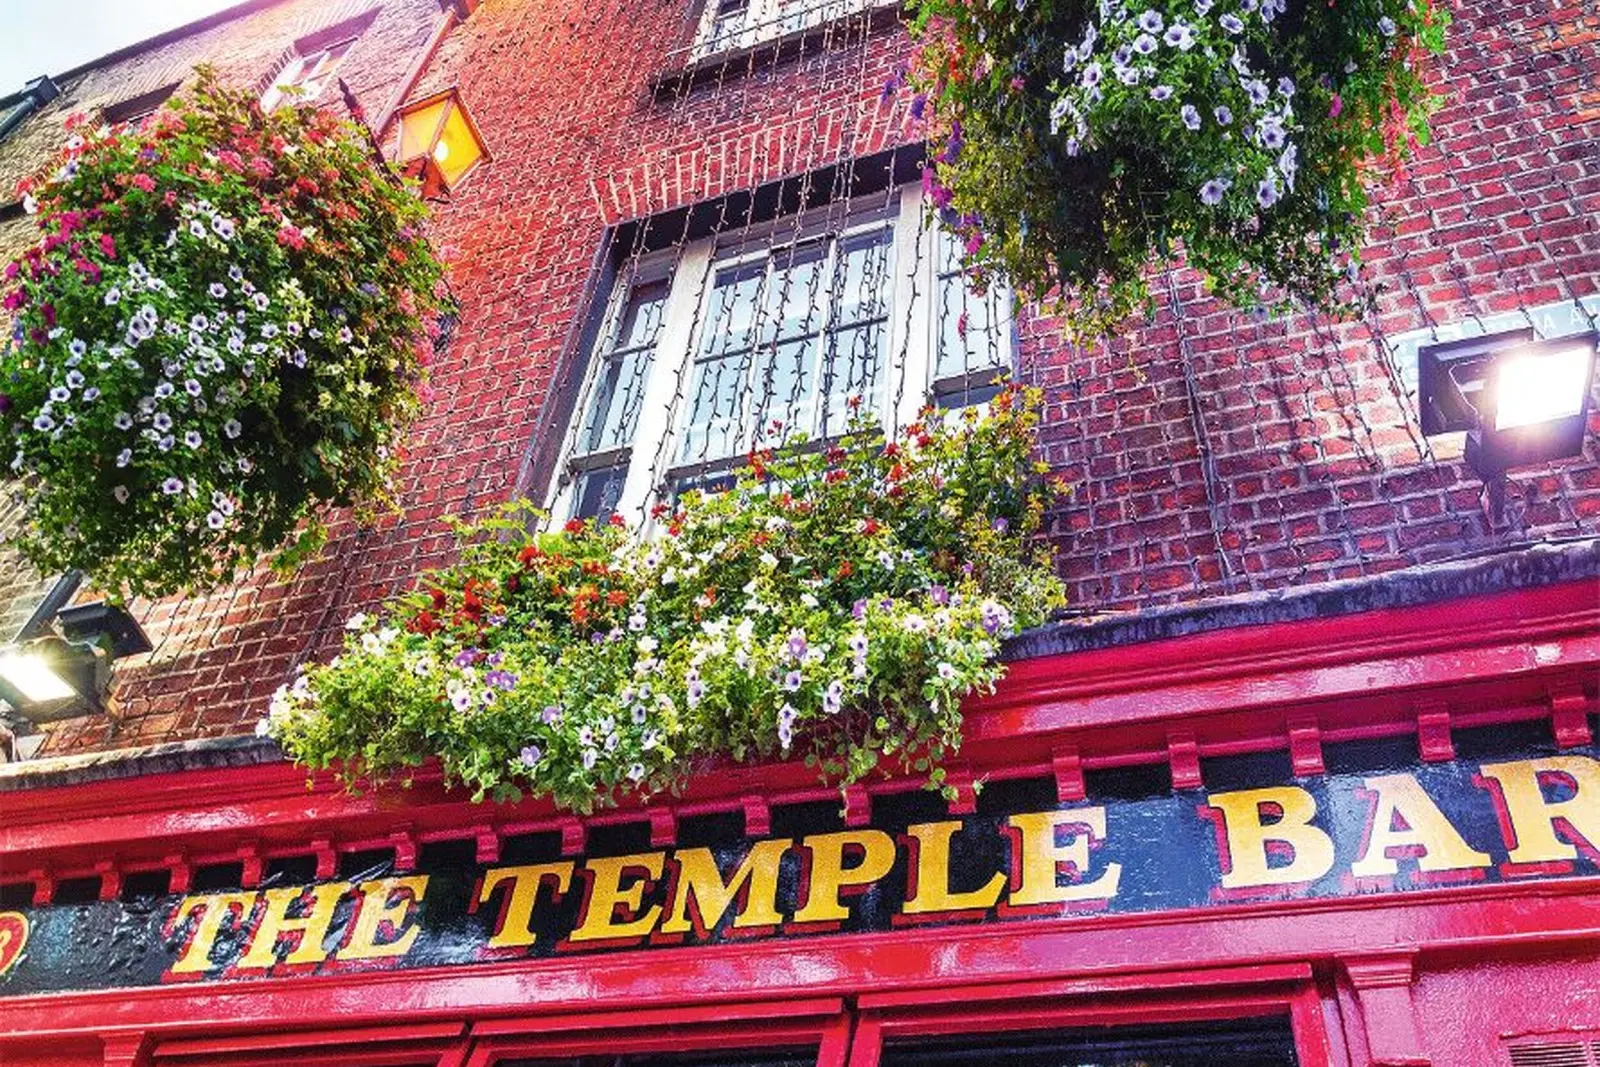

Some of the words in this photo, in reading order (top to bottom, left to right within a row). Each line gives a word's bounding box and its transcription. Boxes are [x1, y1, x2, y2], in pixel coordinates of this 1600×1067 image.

[168, 874, 429, 975] THE
[477, 806, 1122, 950] TEMPLE
[1206, 755, 1600, 891] BAR
